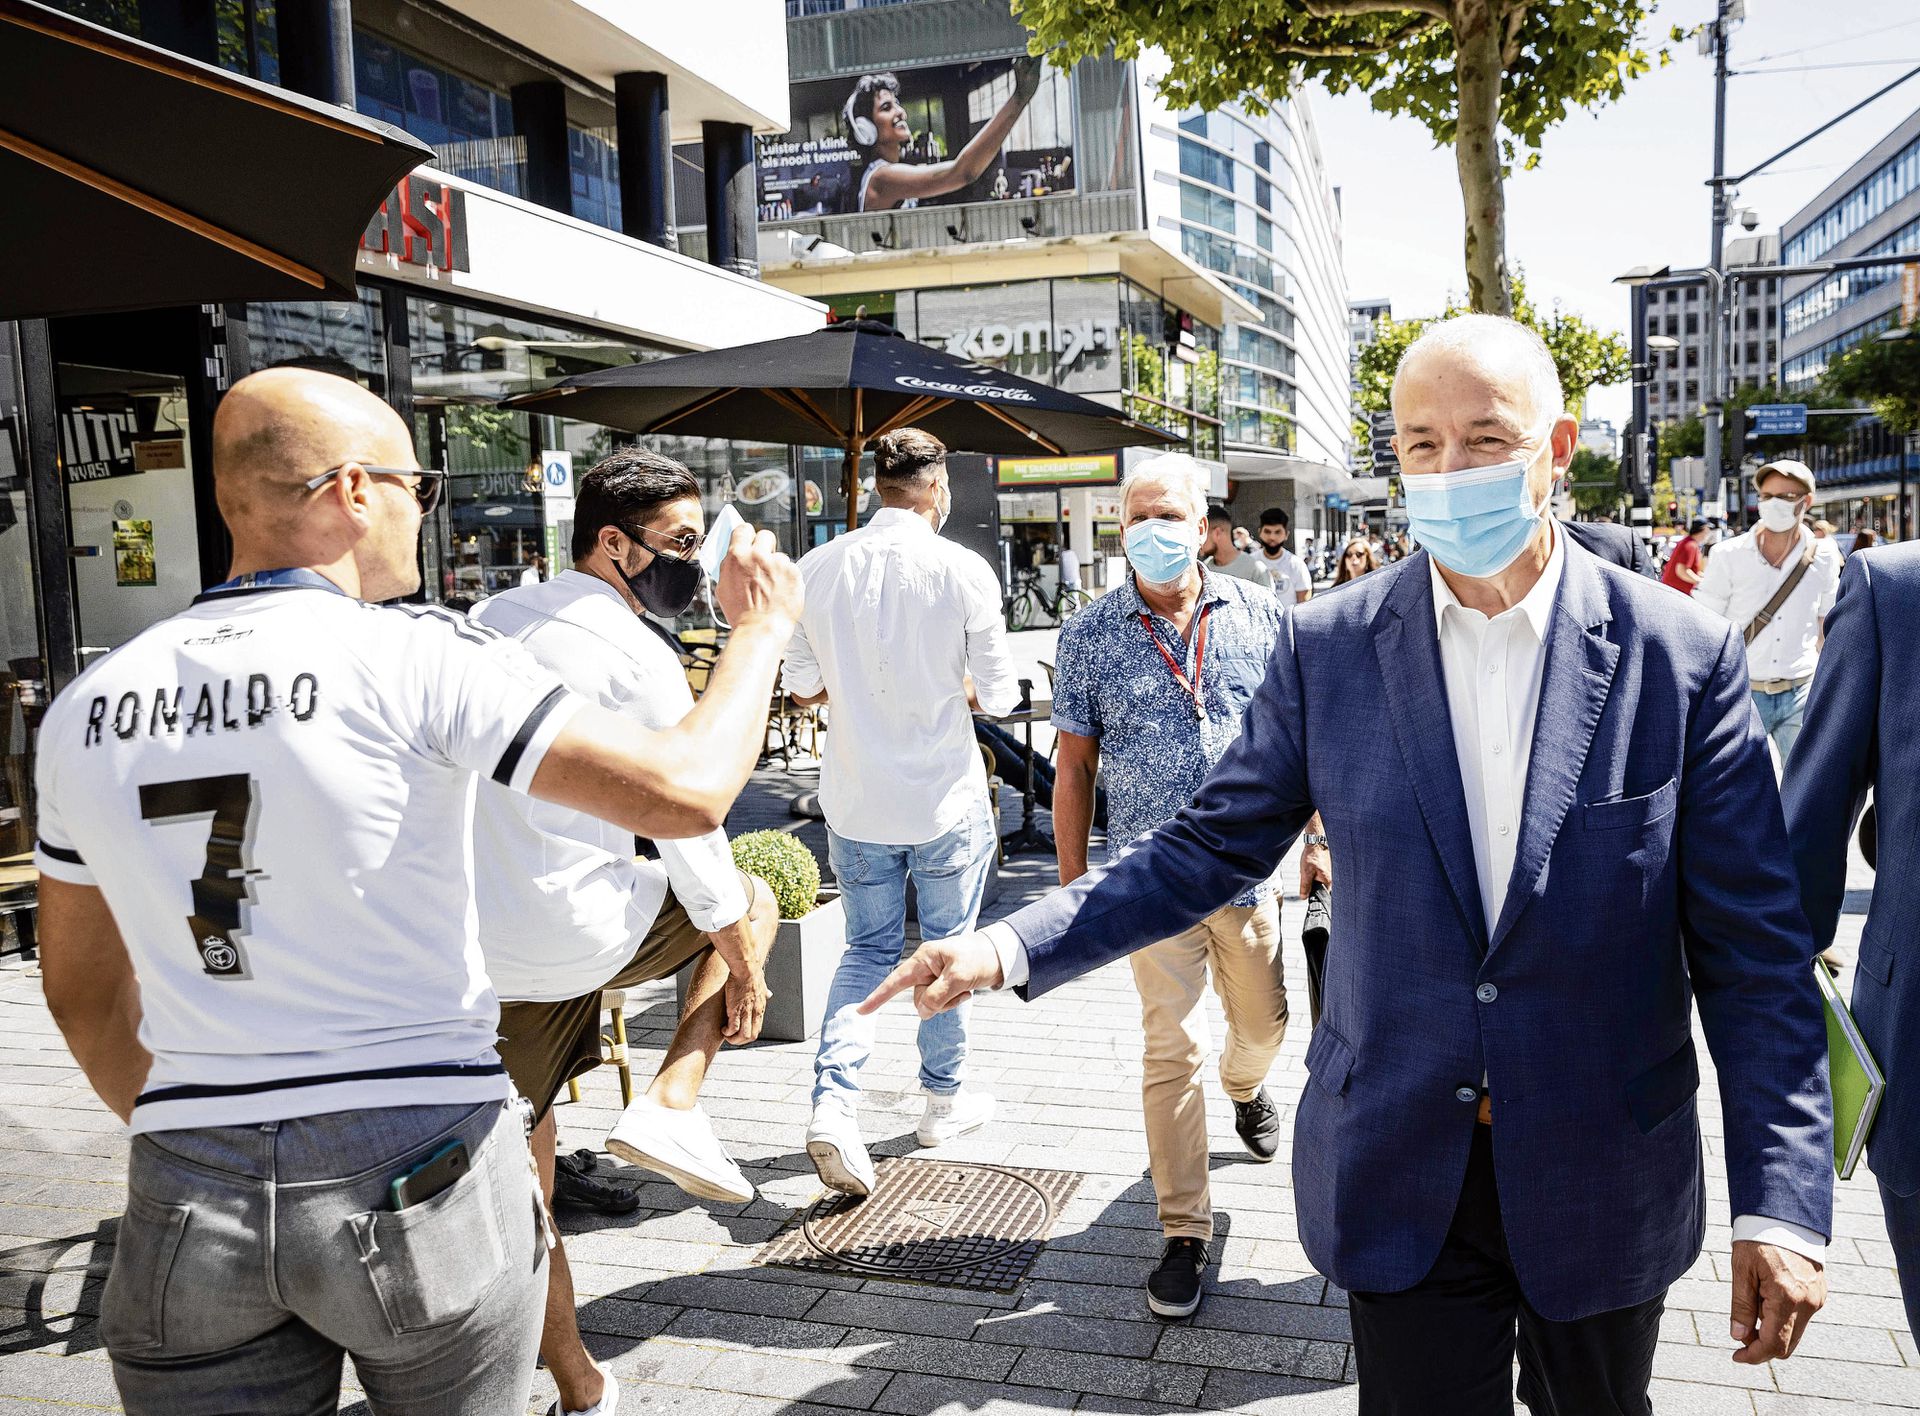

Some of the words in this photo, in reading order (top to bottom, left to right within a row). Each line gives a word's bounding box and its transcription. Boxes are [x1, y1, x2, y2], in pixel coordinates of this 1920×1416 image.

[760, 143, 801, 156] Luister
[802, 141, 818, 152] en
[819, 136, 848, 150] klink
[761, 155, 779, 168] als
[780, 154, 812, 167] nooit
[813, 150, 861, 163] tevoren.
[894, 376, 1037, 402] Coca-Cola
[85, 673, 318, 749] RONALDO
[138, 772, 263, 980] 7
